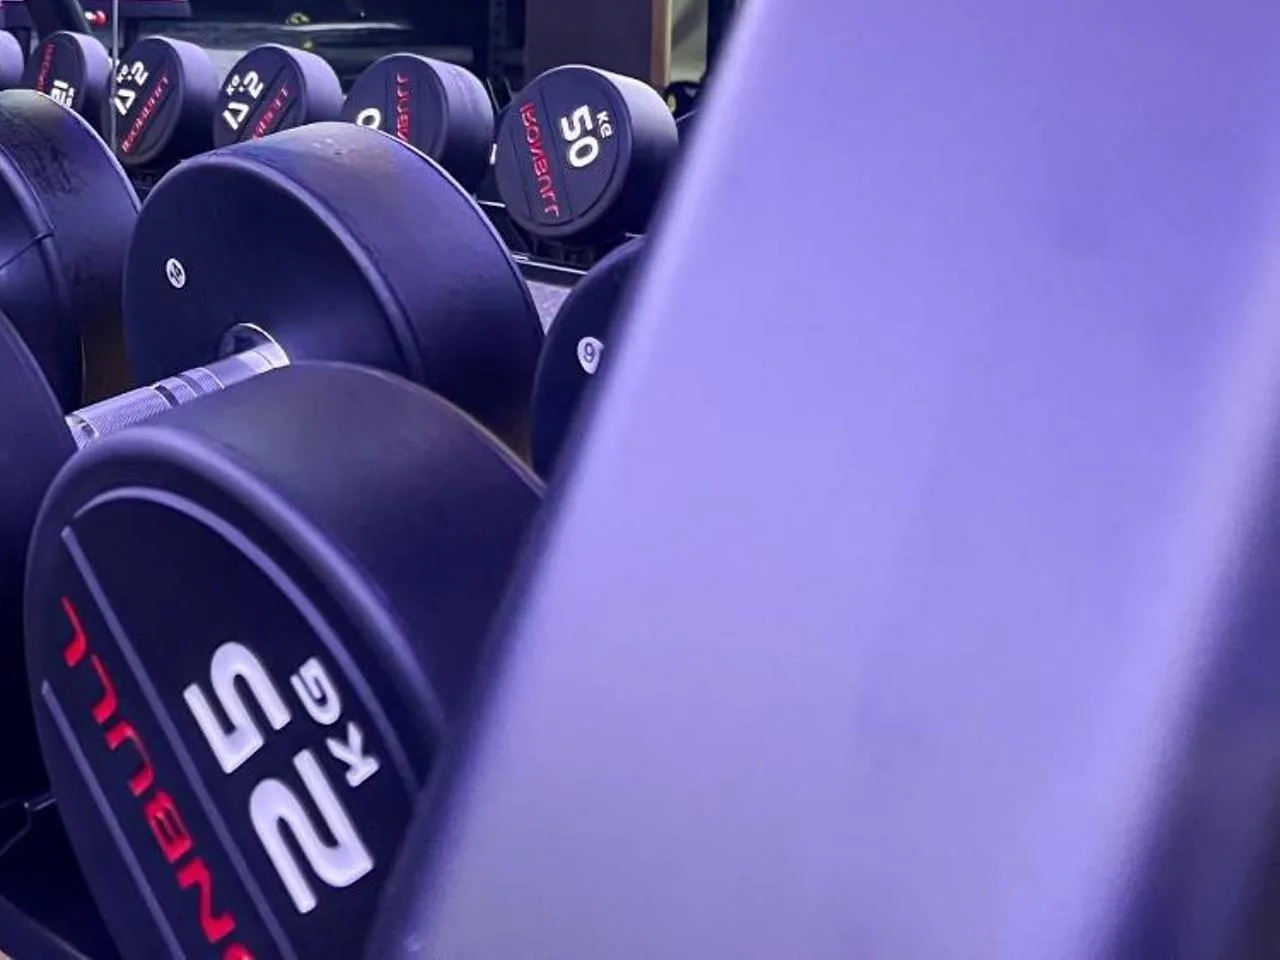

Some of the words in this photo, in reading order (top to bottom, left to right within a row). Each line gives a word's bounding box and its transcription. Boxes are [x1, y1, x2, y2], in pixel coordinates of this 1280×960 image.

[61, 596, 257, 960] NBULL
[183, 641, 375, 914] 25
[290, 657, 381, 788] KG
